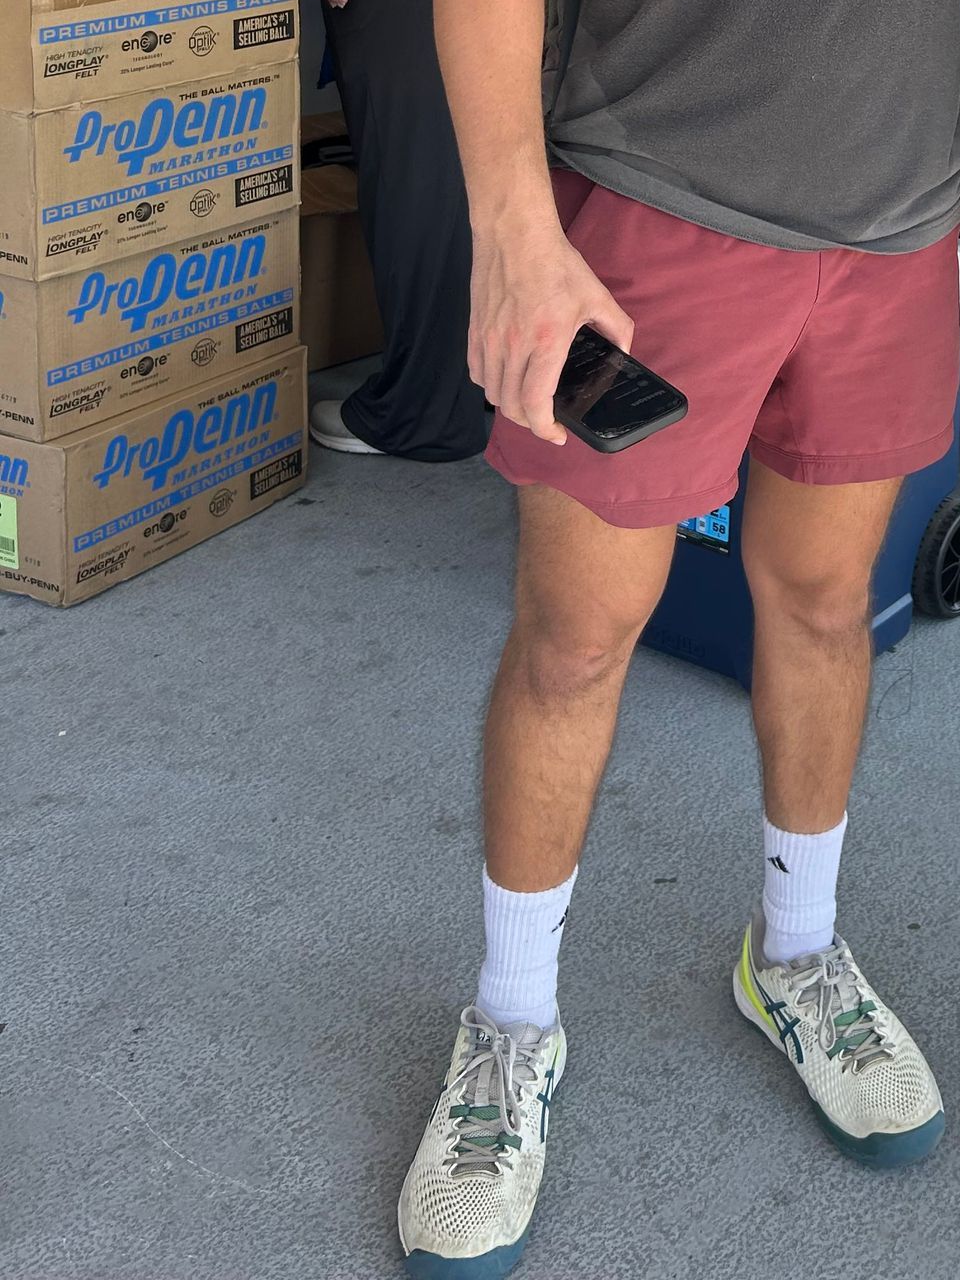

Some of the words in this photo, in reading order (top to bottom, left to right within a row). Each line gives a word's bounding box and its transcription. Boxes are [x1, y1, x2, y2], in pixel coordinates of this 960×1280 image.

[43, 14, 146, 42] PREMIUM
[155, 0, 228, 23] TENNIS
[239, 14, 278, 33] AMERICA'S
[279, 12, 289, 24] #1
[239, 29, 268, 46] SELLING
[46, 53, 65, 62] HIGH
[67, 46, 103, 58] TENACITY
[75, 69, 99, 80] FELT
[179, 91, 198, 101] THE
[201, 86, 225, 97] BALL
[63, 87, 266, 177] ProPenn
[149, 137, 258, 175] MARATHON
[45, 186, 147, 221] PREMIUM
[157, 165, 228, 191] TENNIS
[237, 147, 292, 170] BALLS
[240, 170, 278, 191] AMERICA'S
[279, 167, 288, 178] #1
[240, 185, 268, 203] SELLING
[48, 233, 66, 242] HIGH
[68, 223, 102, 236] TENACITY
[75, 244, 99, 255] FELT
[180, 244, 198, 255] THE
[202, 237, 225, 249] BALL
[67, 234, 266, 333] ProPenn
[152, 283, 258, 329] MARATHON
[240, 314, 277, 337] AMERICA'S
[50, 339, 150, 383] PREMIUM
[160, 312, 229, 344] TENNIS
[237, 290, 293, 317] BALLS
[240, 329, 268, 349] SELLING
[72, 380, 106, 398] TENACITY
[198, 399, 215, 410] THE
[218, 387, 240, 402] BALL
[80, 400, 101, 414] FELT
[93, 381, 278, 492] ProPenn
[172, 429, 270, 486] MARATHON
[77, 498, 171, 549] PREMIUM
[180, 461, 246, 499] TENNIS
[251, 430, 303, 465] BALLS
[712, 521, 726, 535] 58
[98, 541, 130, 560] TENACITY
[104, 562, 125, 577] FELT
